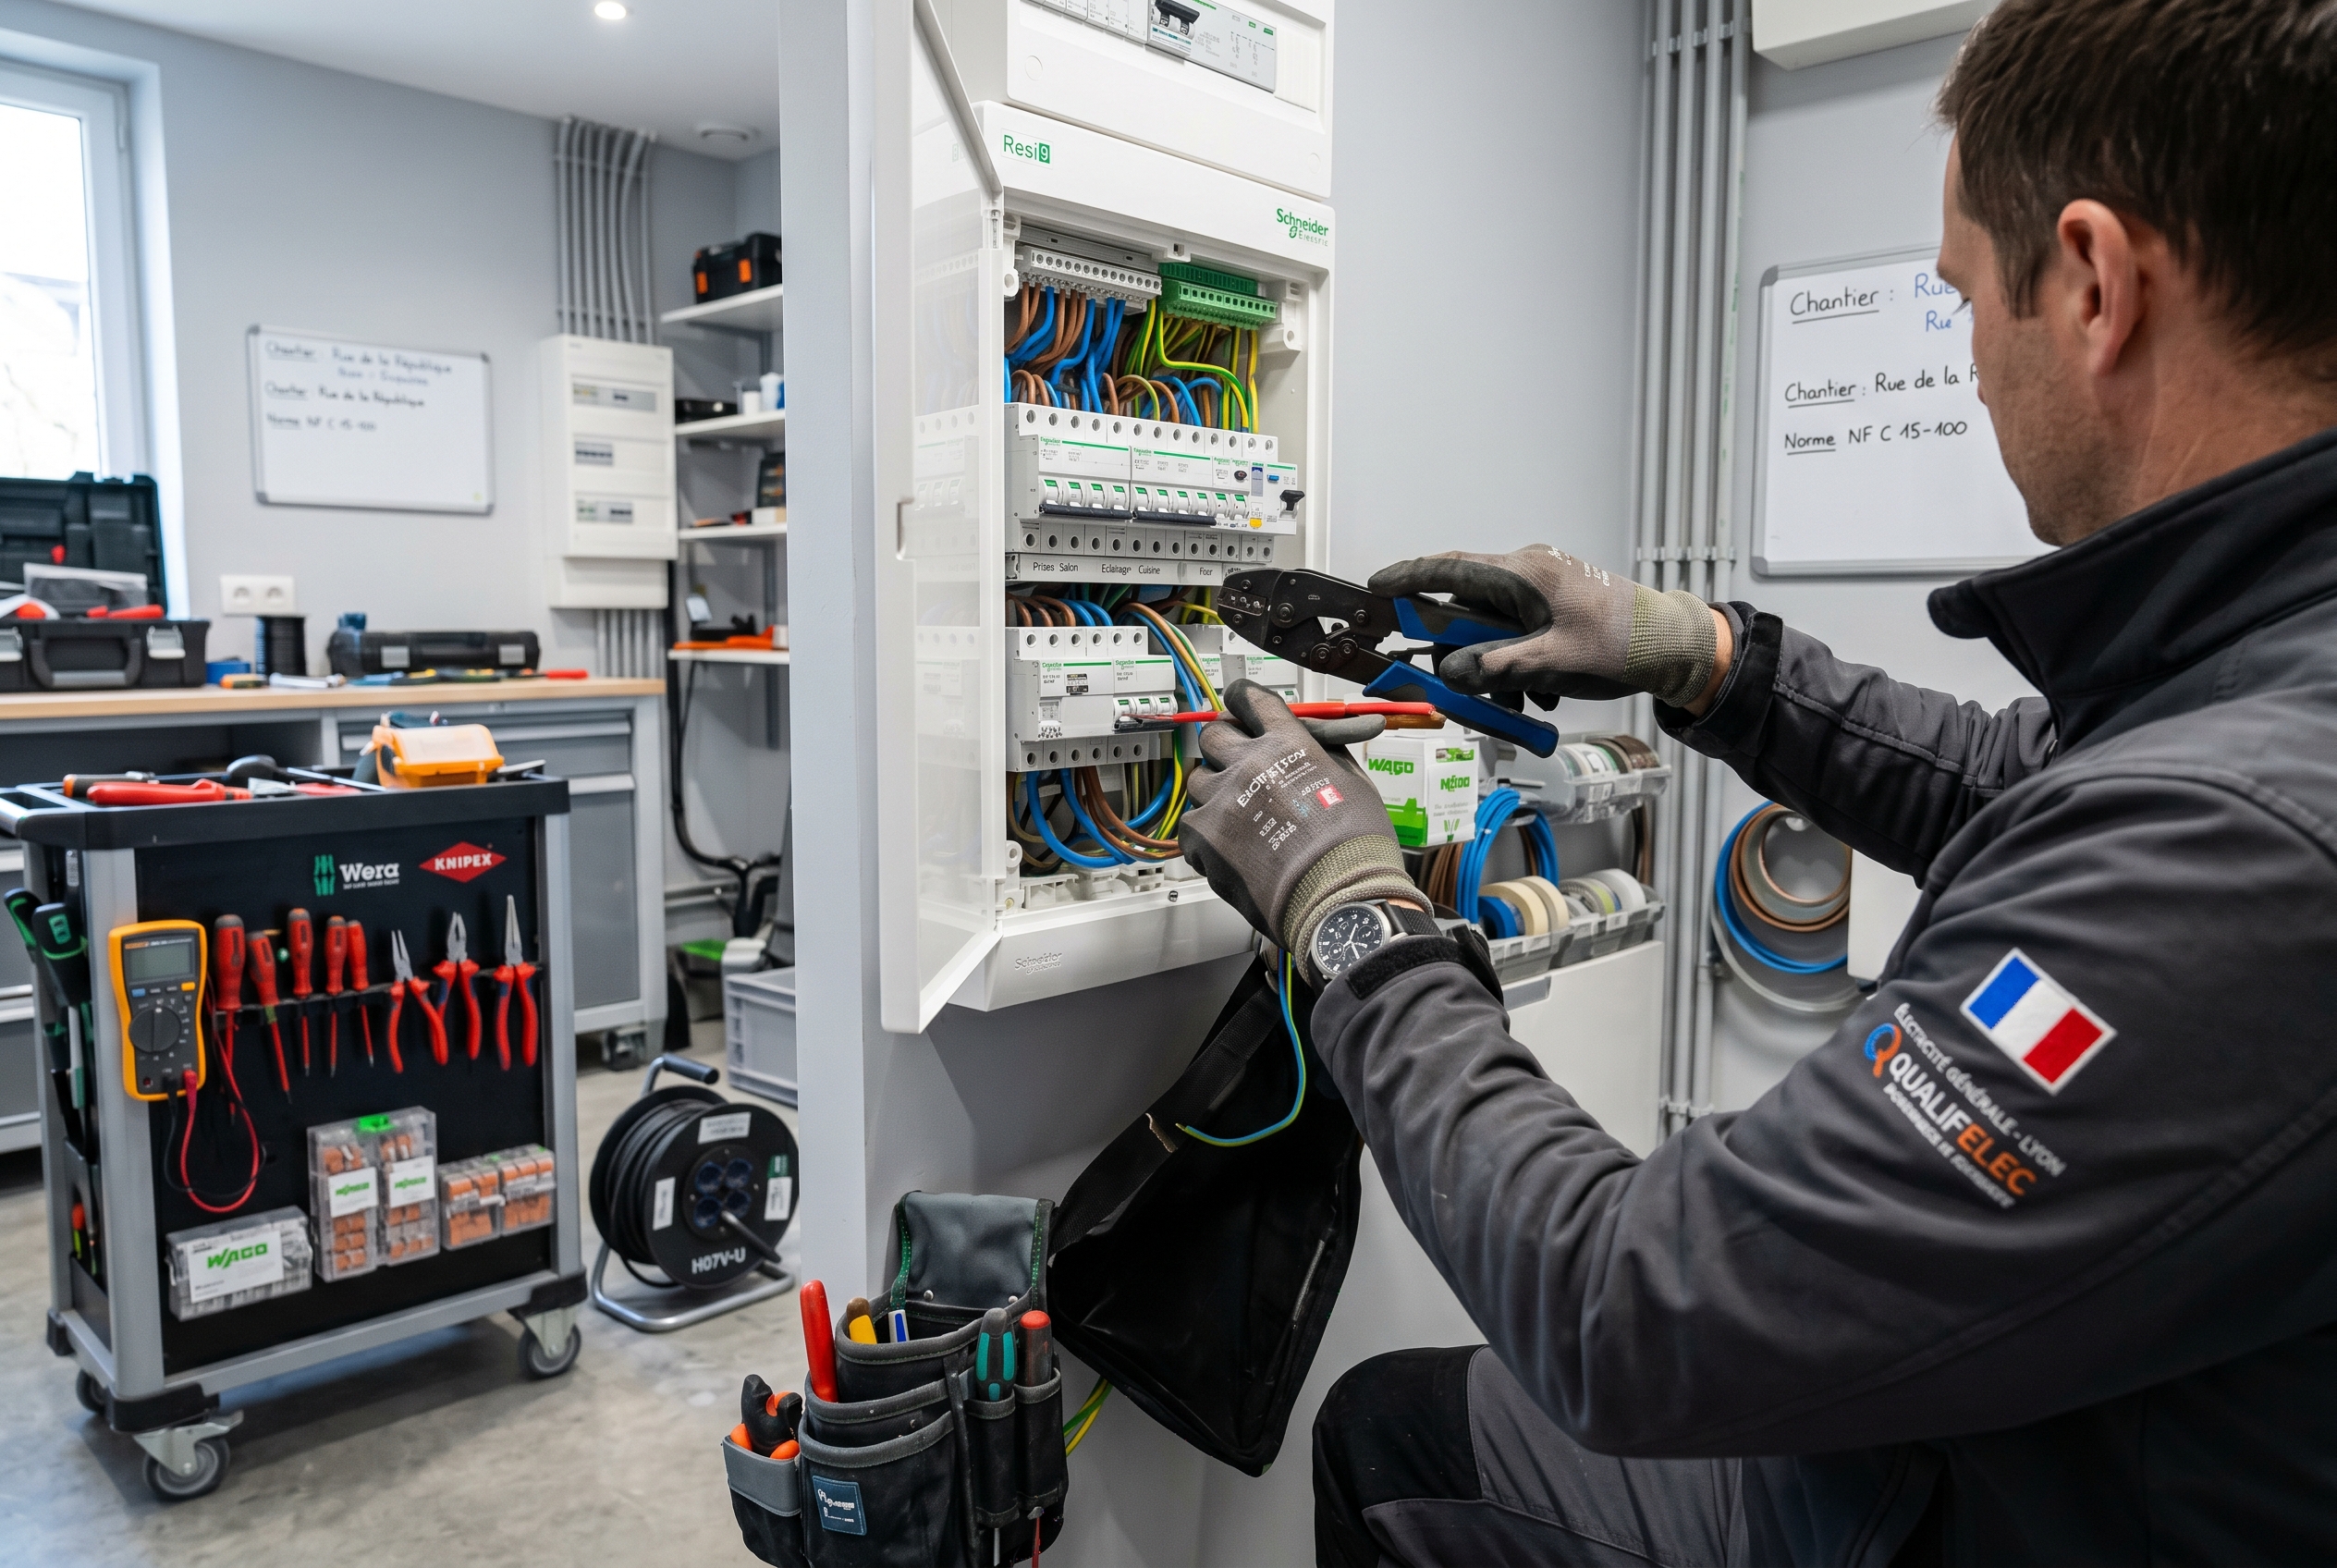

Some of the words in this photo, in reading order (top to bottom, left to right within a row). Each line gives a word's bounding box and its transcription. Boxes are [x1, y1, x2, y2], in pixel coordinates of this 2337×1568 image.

[1276, 207, 1329, 237] Schneider
[1790, 286, 1879, 316] Chantier
[1784, 378, 1857, 403] Chantier
[1875, 372, 1907, 393] Rue
[1914, 369, 1936, 389] de
[1944, 364, 1960, 386] la
[1784, 432, 1837, 449] Norme
[1848, 425, 1873, 444] NF
[1879, 424, 1891, 442] C
[1900, 421, 1968, 440] 15-100
[1032, 561, 1055, 572] Prises
[1058, 562, 1079, 573] Salon
[1138, 564, 1161, 575] Cuisine
[339, 863, 400, 883] Wera
[434, 852, 493, 872] KNIPEX
[1888, 1051, 2037, 1196] QUALIFELEC
[2017, 1133, 2068, 1178] LYON
[691, 1246, 746, 1274] H07V-U
